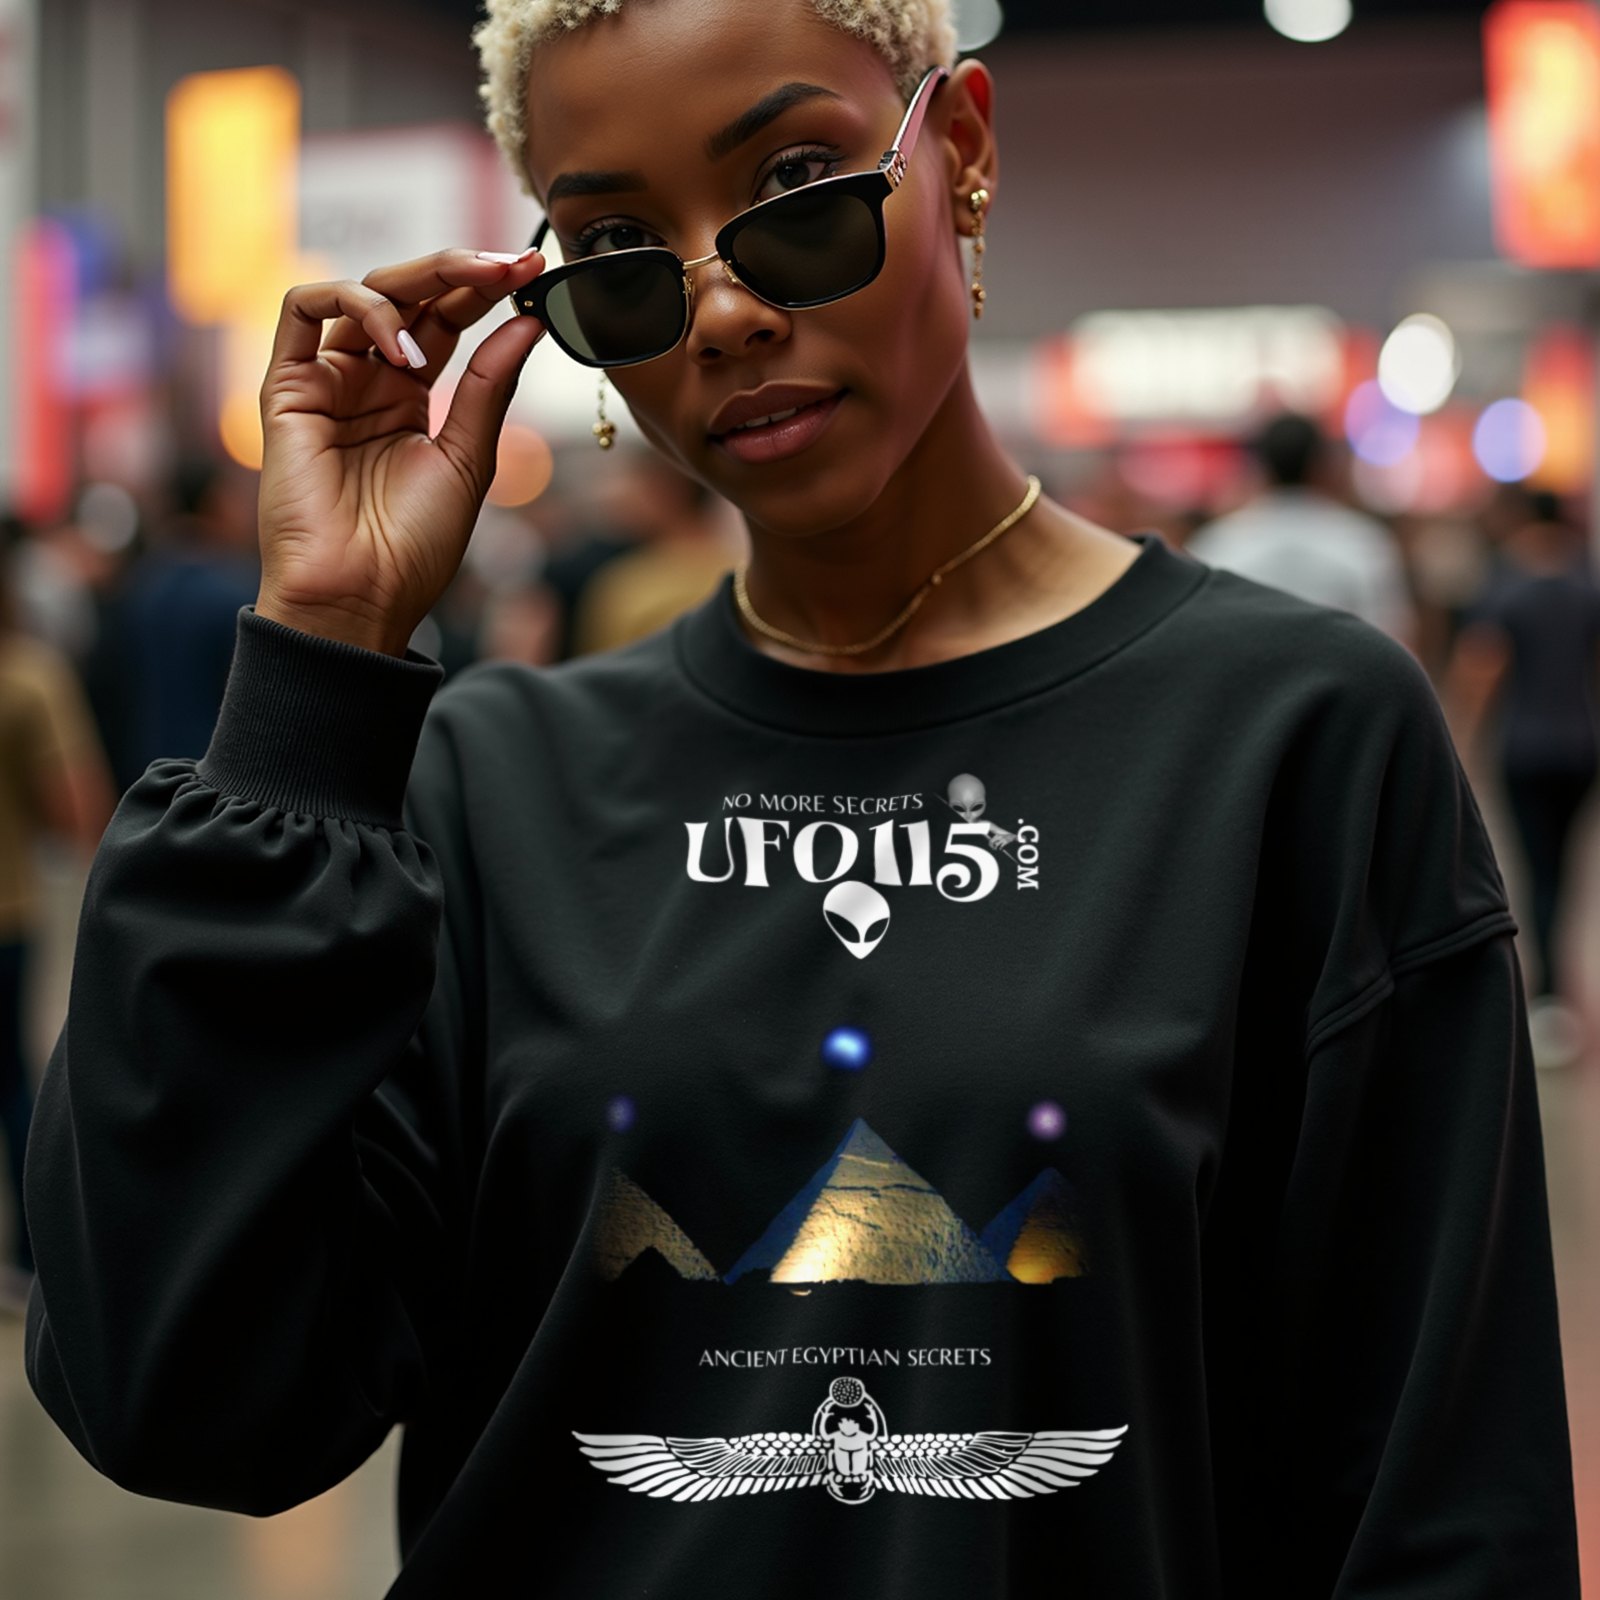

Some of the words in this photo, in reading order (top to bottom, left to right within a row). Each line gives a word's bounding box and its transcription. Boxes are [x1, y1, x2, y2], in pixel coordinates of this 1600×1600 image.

[722, 792, 752, 811] NO
[759, 794, 826, 813] MORE
[832, 793, 924, 815] SECRETS
[684, 816, 1000, 903] UFO115
[1016, 818, 1040, 891] .COM
[699, 1348, 788, 1368] ANCIENT
[791, 1346, 900, 1366] EGYPTIAN
[906, 1347, 992, 1367] SECRETS
